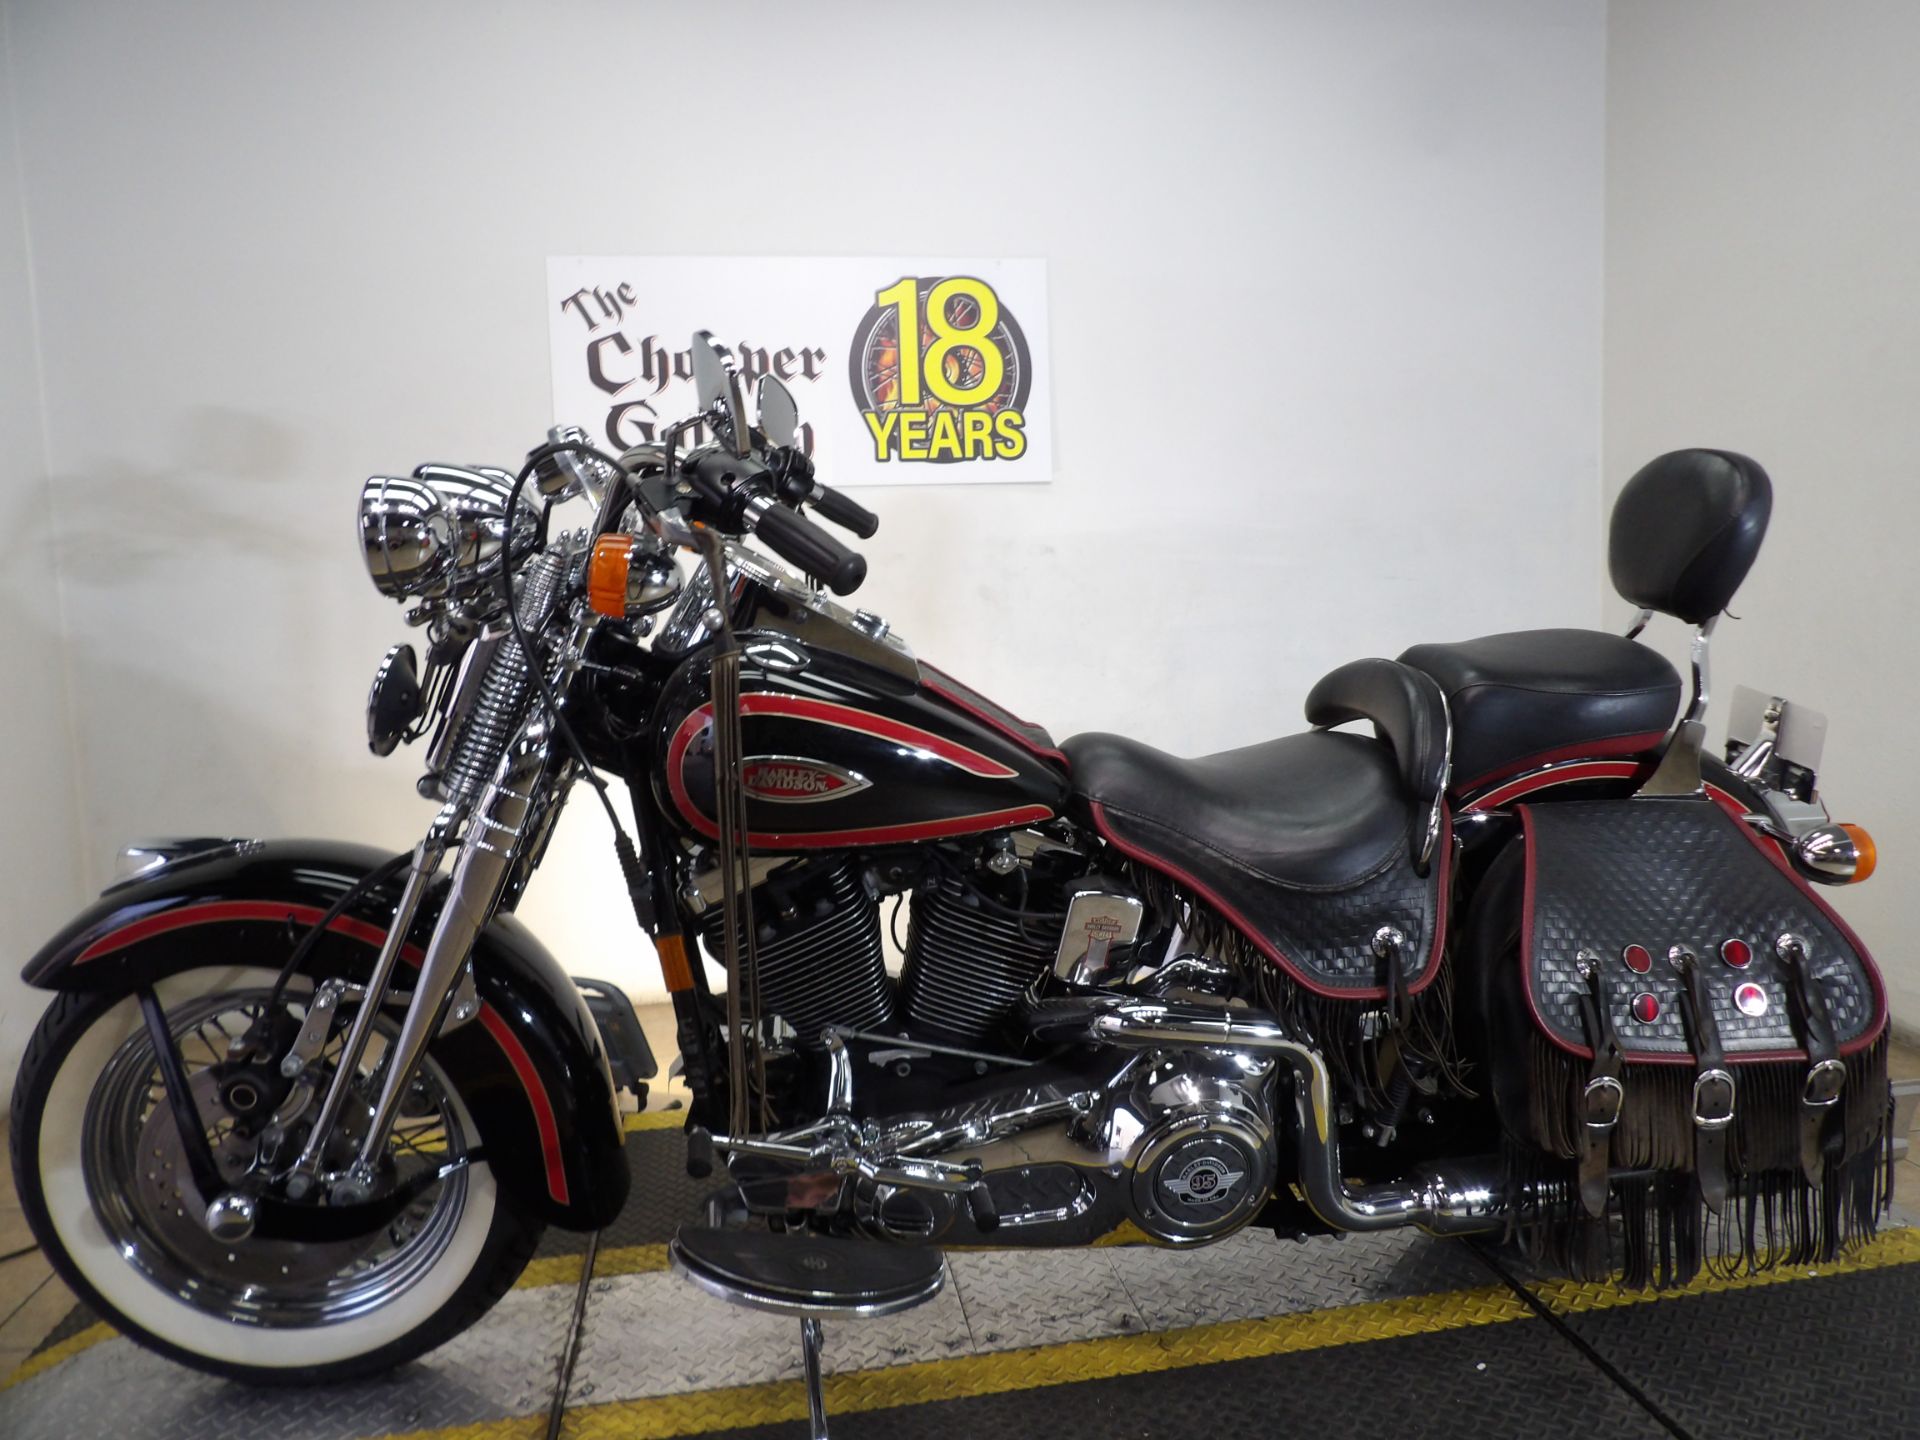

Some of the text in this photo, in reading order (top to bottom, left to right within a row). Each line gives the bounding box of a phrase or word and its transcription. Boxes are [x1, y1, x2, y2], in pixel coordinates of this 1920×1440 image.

[561, 281, 639, 332] The
[587, 331, 828, 397] Choper
[876, 277, 1004, 406] 18
[863, 410, 1026, 460] YEARS
[1191, 1173, 1216, 1191] 95
